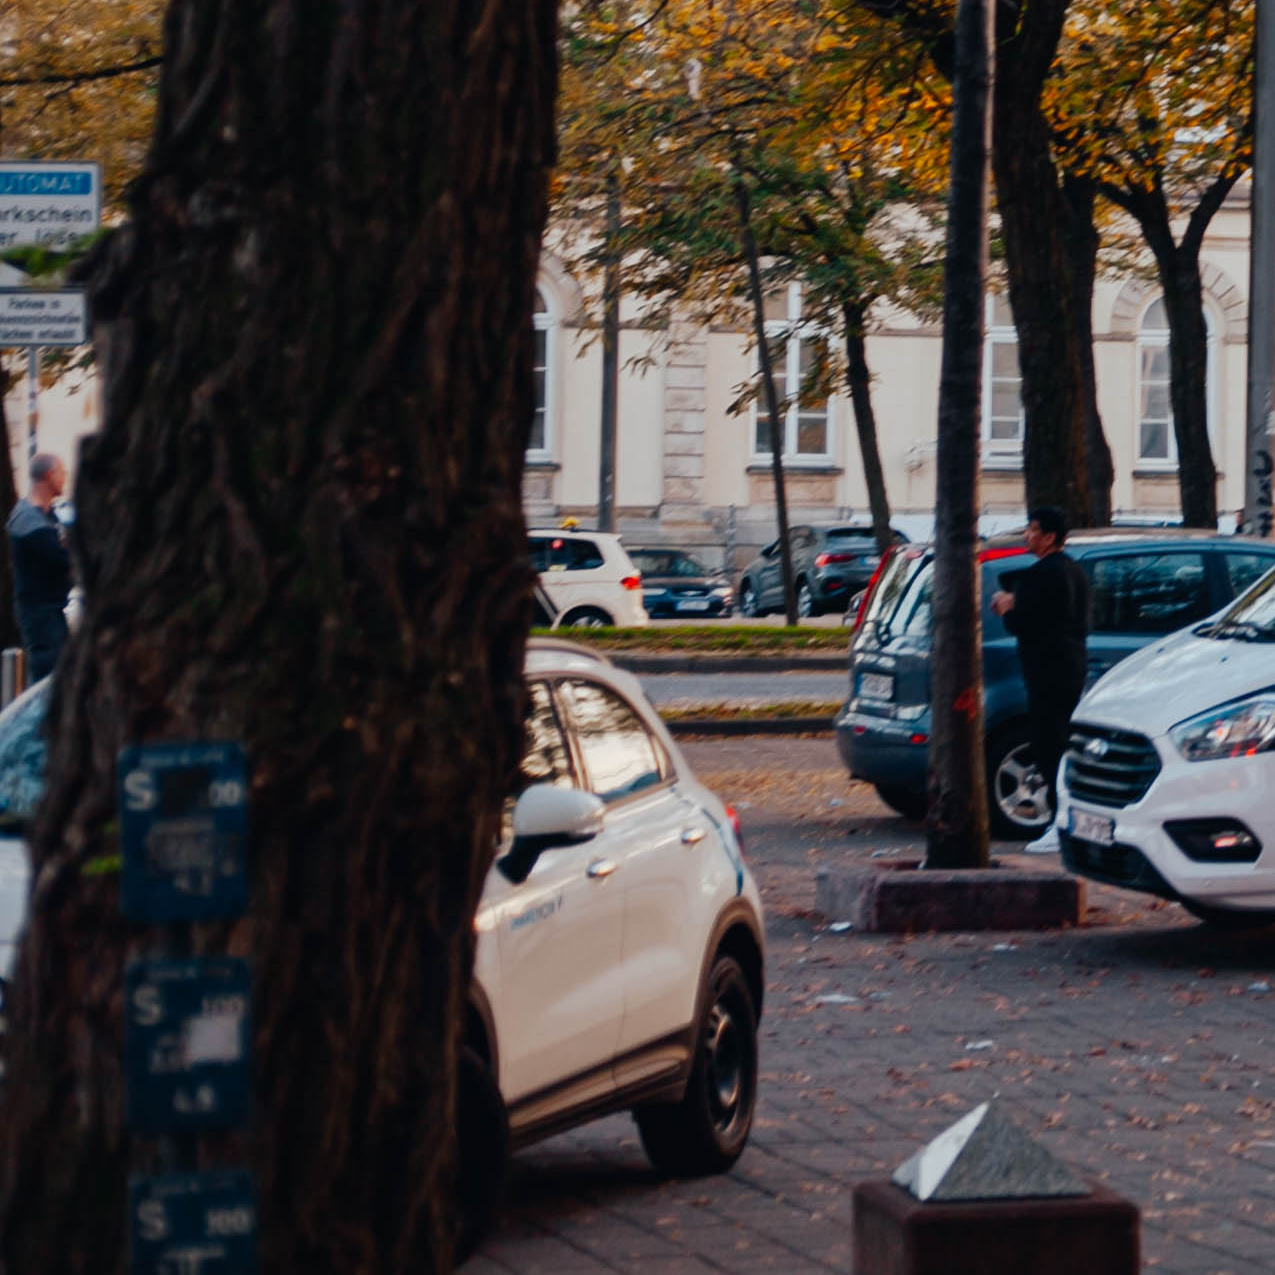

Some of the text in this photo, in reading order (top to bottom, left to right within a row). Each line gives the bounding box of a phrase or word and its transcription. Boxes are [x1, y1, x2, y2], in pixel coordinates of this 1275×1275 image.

[0, 173, 84, 191] UTOMAT
[125, 771, 155, 811] S
[133, 983, 164, 1026] S
[137, 1200, 167, 1241] S
